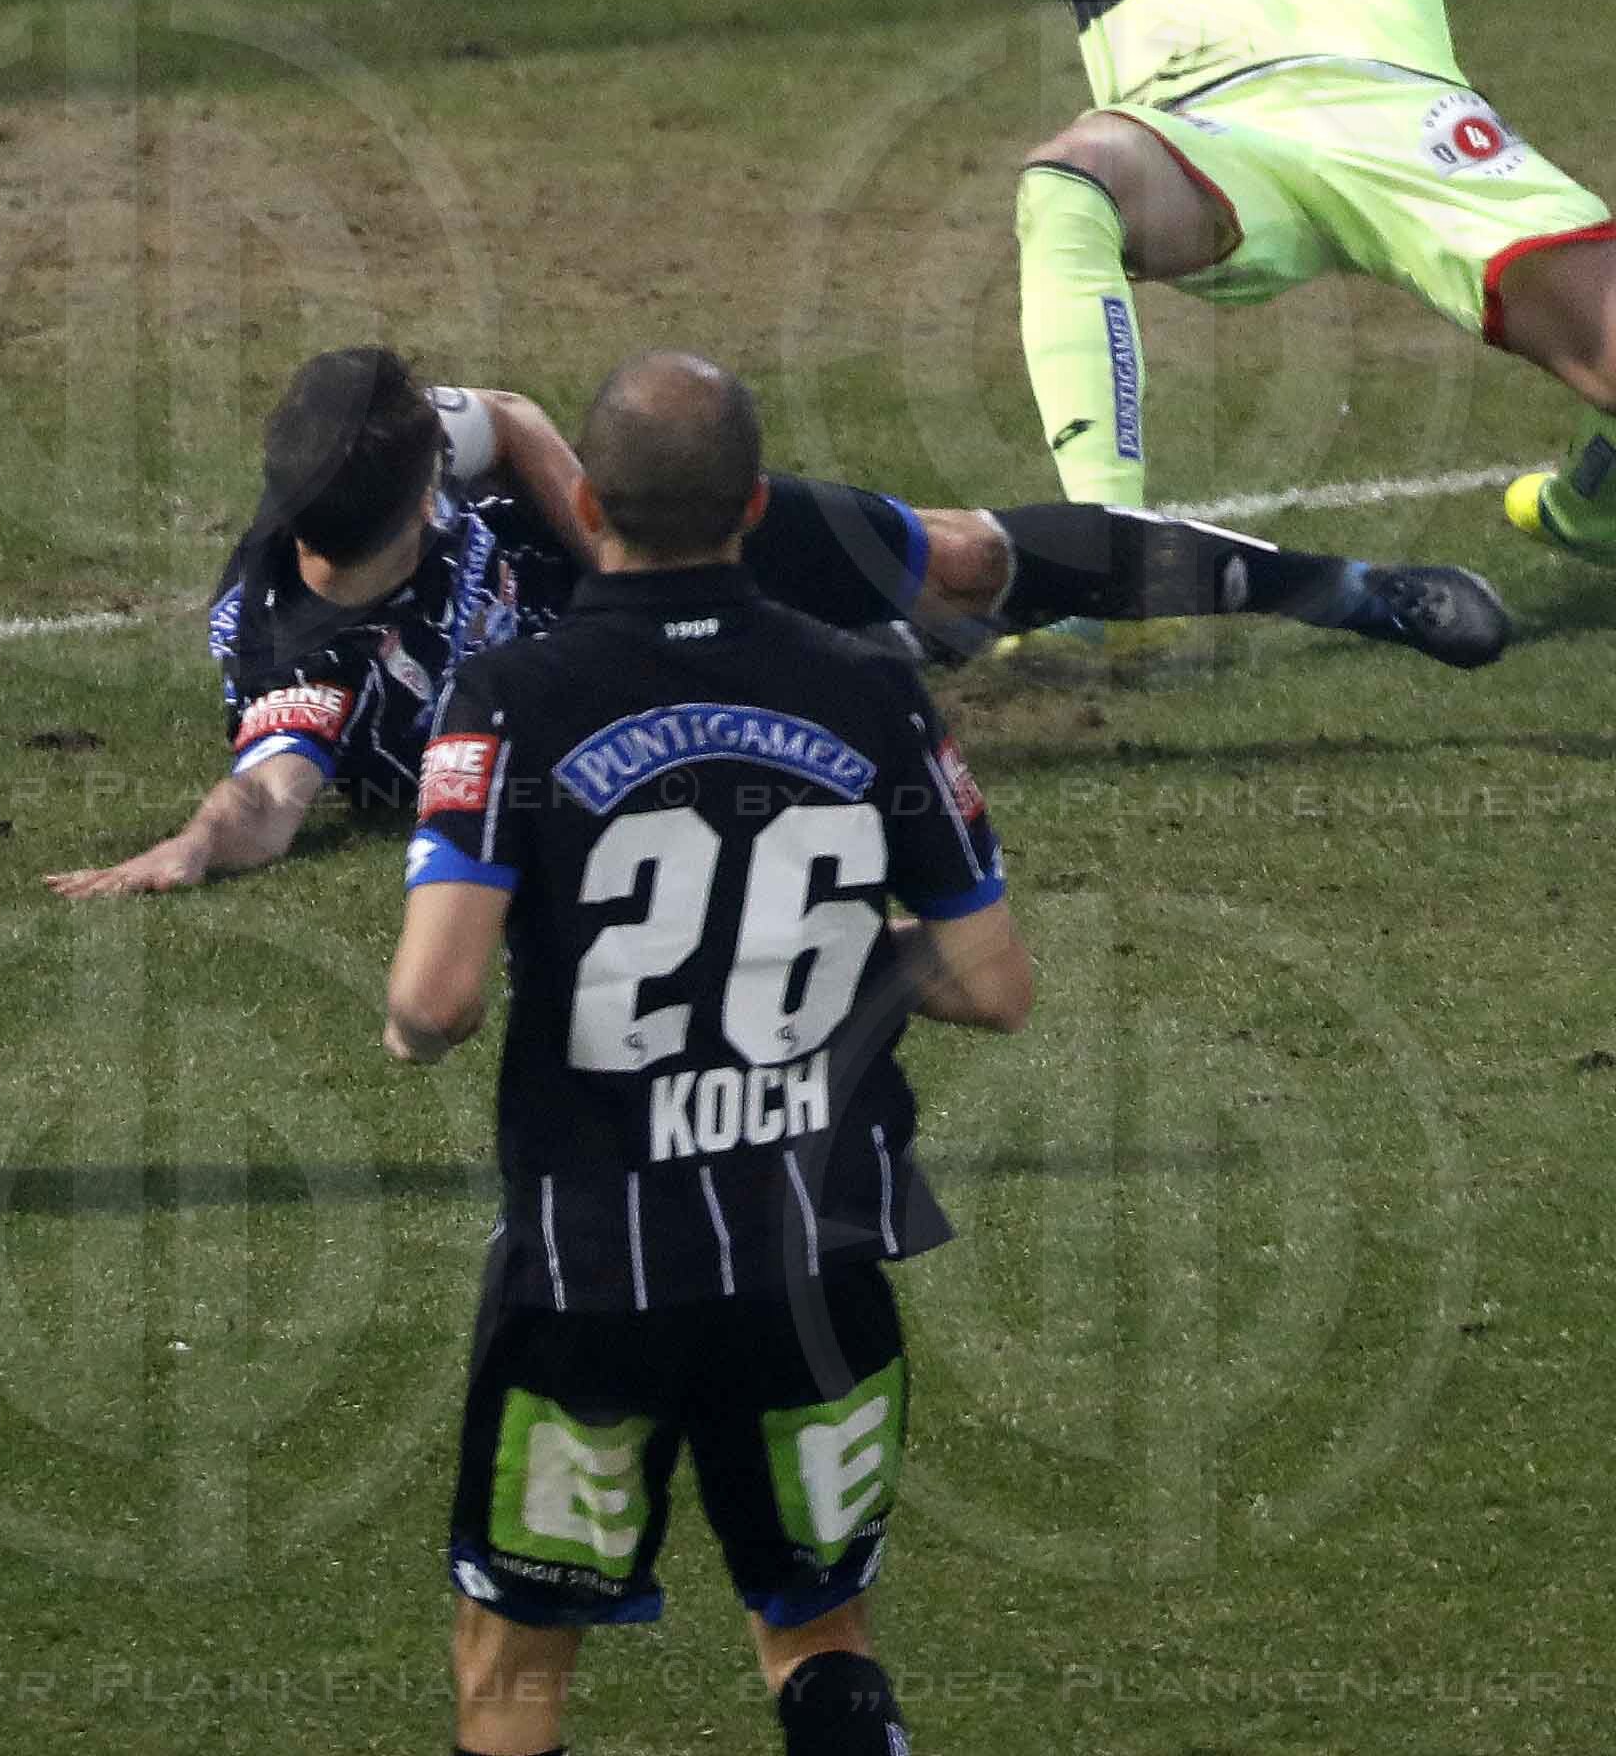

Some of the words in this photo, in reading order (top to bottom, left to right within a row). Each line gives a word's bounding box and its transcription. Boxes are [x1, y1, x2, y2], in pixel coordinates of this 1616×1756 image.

[572, 707, 872, 798] PUNTIGAMER
[567, 805, 887, 1073] 26
[648, 1052, 831, 1162] KOCH
